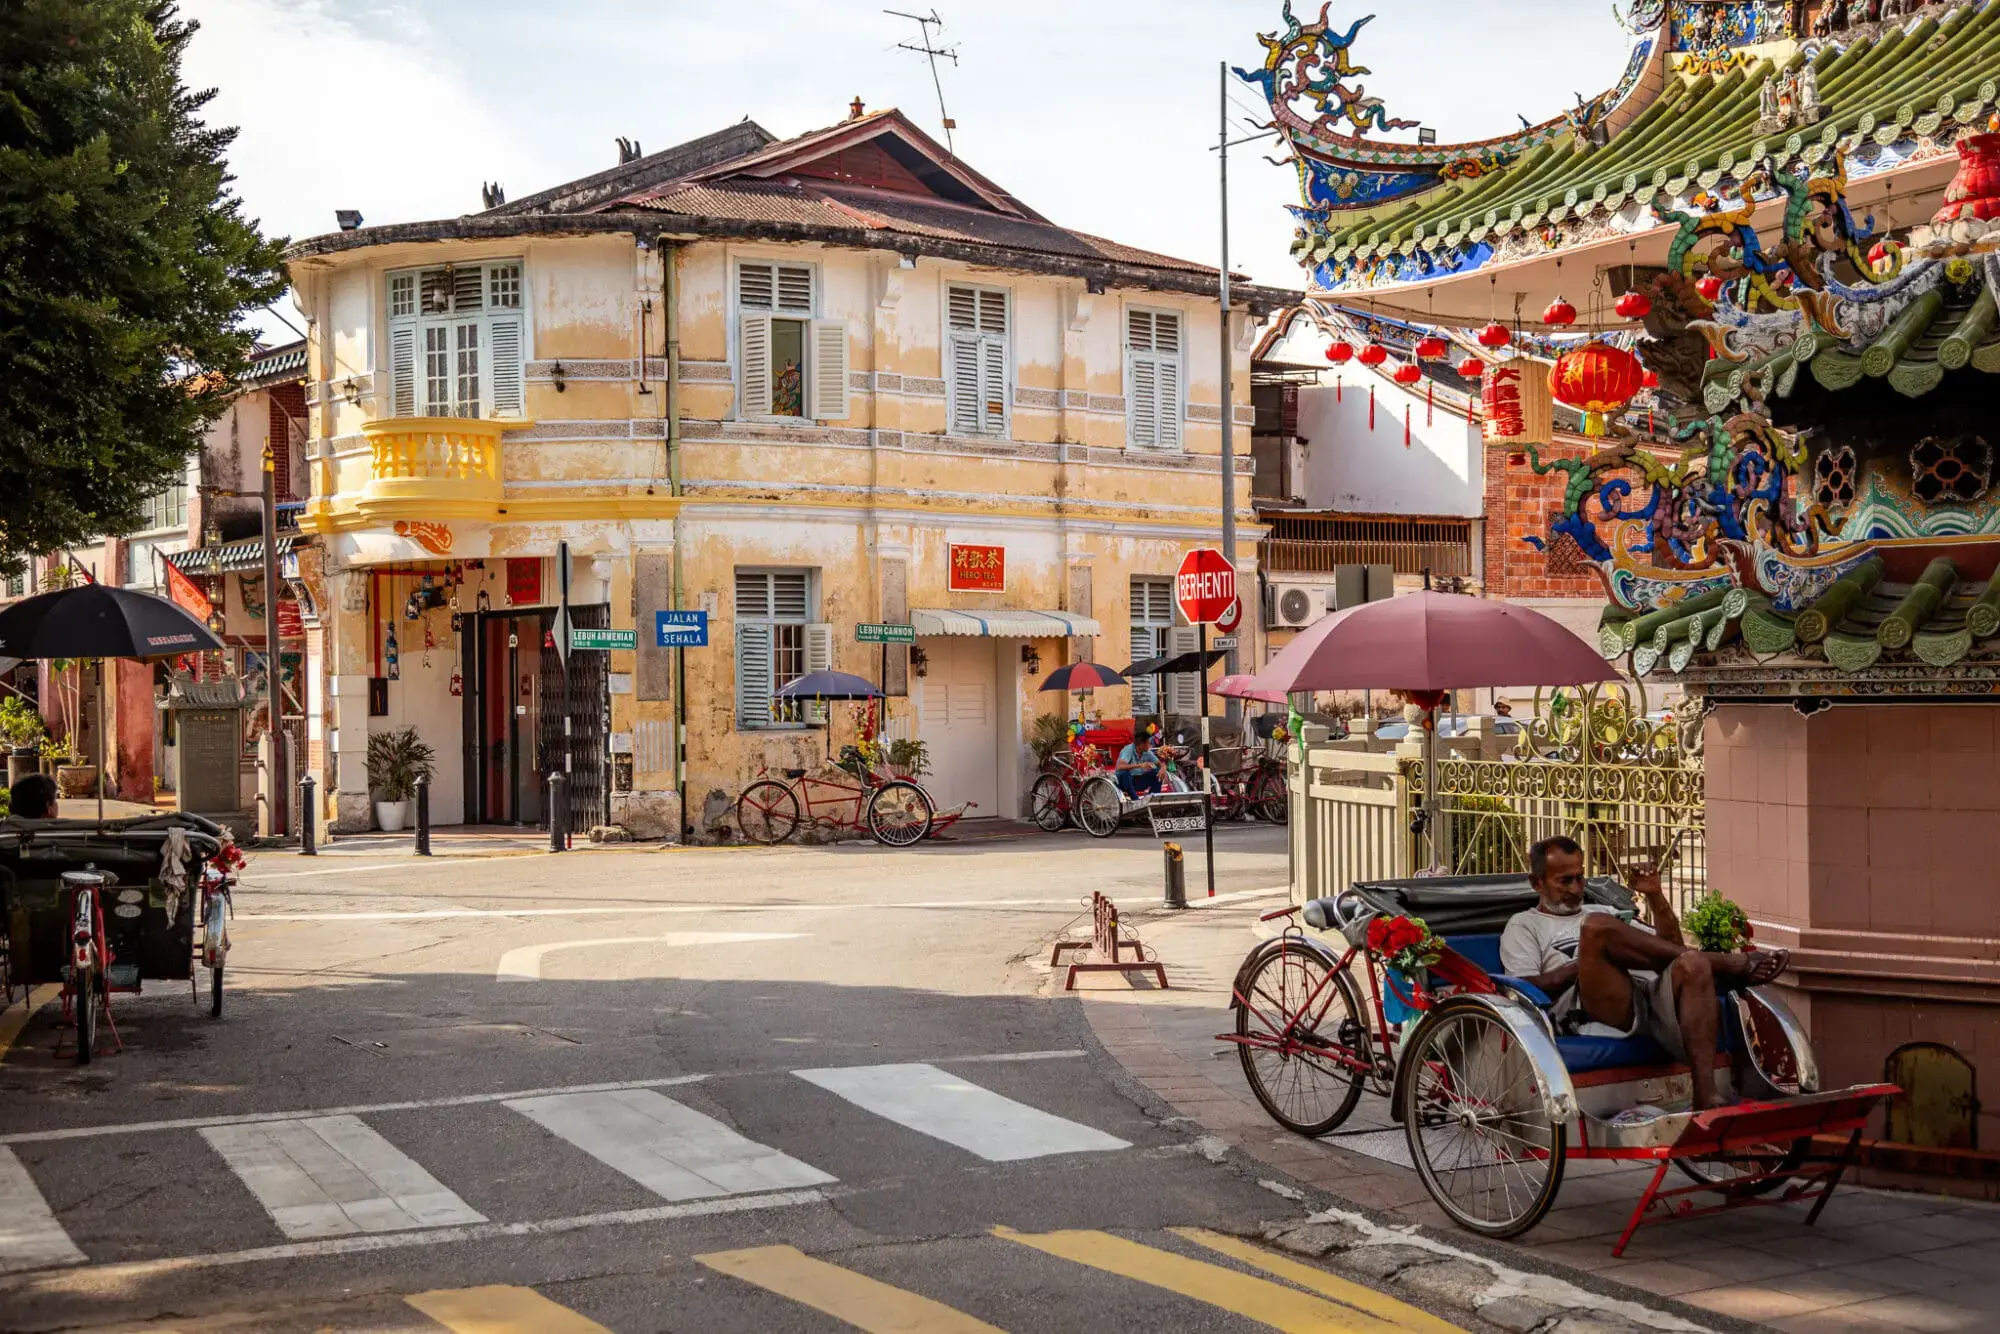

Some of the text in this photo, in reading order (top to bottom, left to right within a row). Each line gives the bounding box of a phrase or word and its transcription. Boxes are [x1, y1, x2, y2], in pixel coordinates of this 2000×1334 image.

[1180, 571, 1232, 601] BERHENTI
[667, 614, 698, 623] JALAN
[859, 625, 913, 636] LEBUH CANNON
[573, 631, 634, 641] LEBUH ARMENIAN
[663, 634, 702, 644] SEHALA
